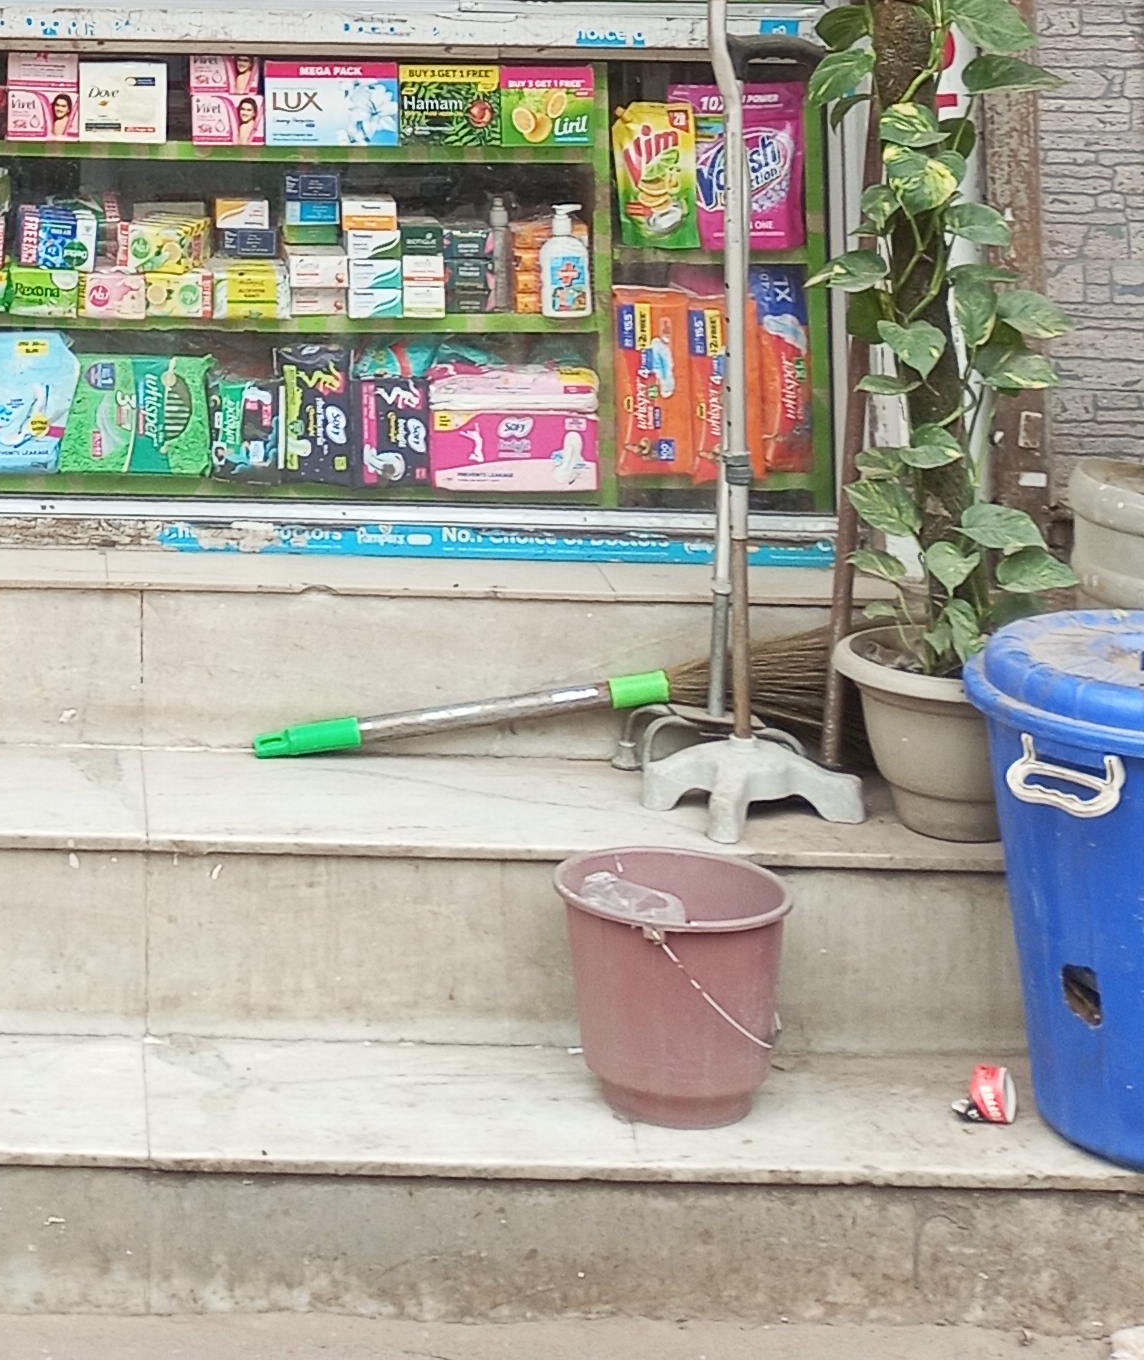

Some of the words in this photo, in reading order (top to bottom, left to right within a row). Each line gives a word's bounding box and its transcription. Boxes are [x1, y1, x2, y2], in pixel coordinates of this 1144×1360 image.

[299, 66, 331, 77] MEGA
[332, 66, 363, 77] PACK
[408, 68, 426, 79] BUY
[437, 68, 455, 79] GET
[508, 79, 526, 89] BUY
[535, 79, 552, 89] GET
[88, 85, 120, 99] Dove
[747, 93, 779, 103] POWER
[272, 91, 324, 112] LUX
[402, 95, 463, 112] Hamam
[623, 124, 679, 187] Vim
[773, 277, 794, 303] XL
